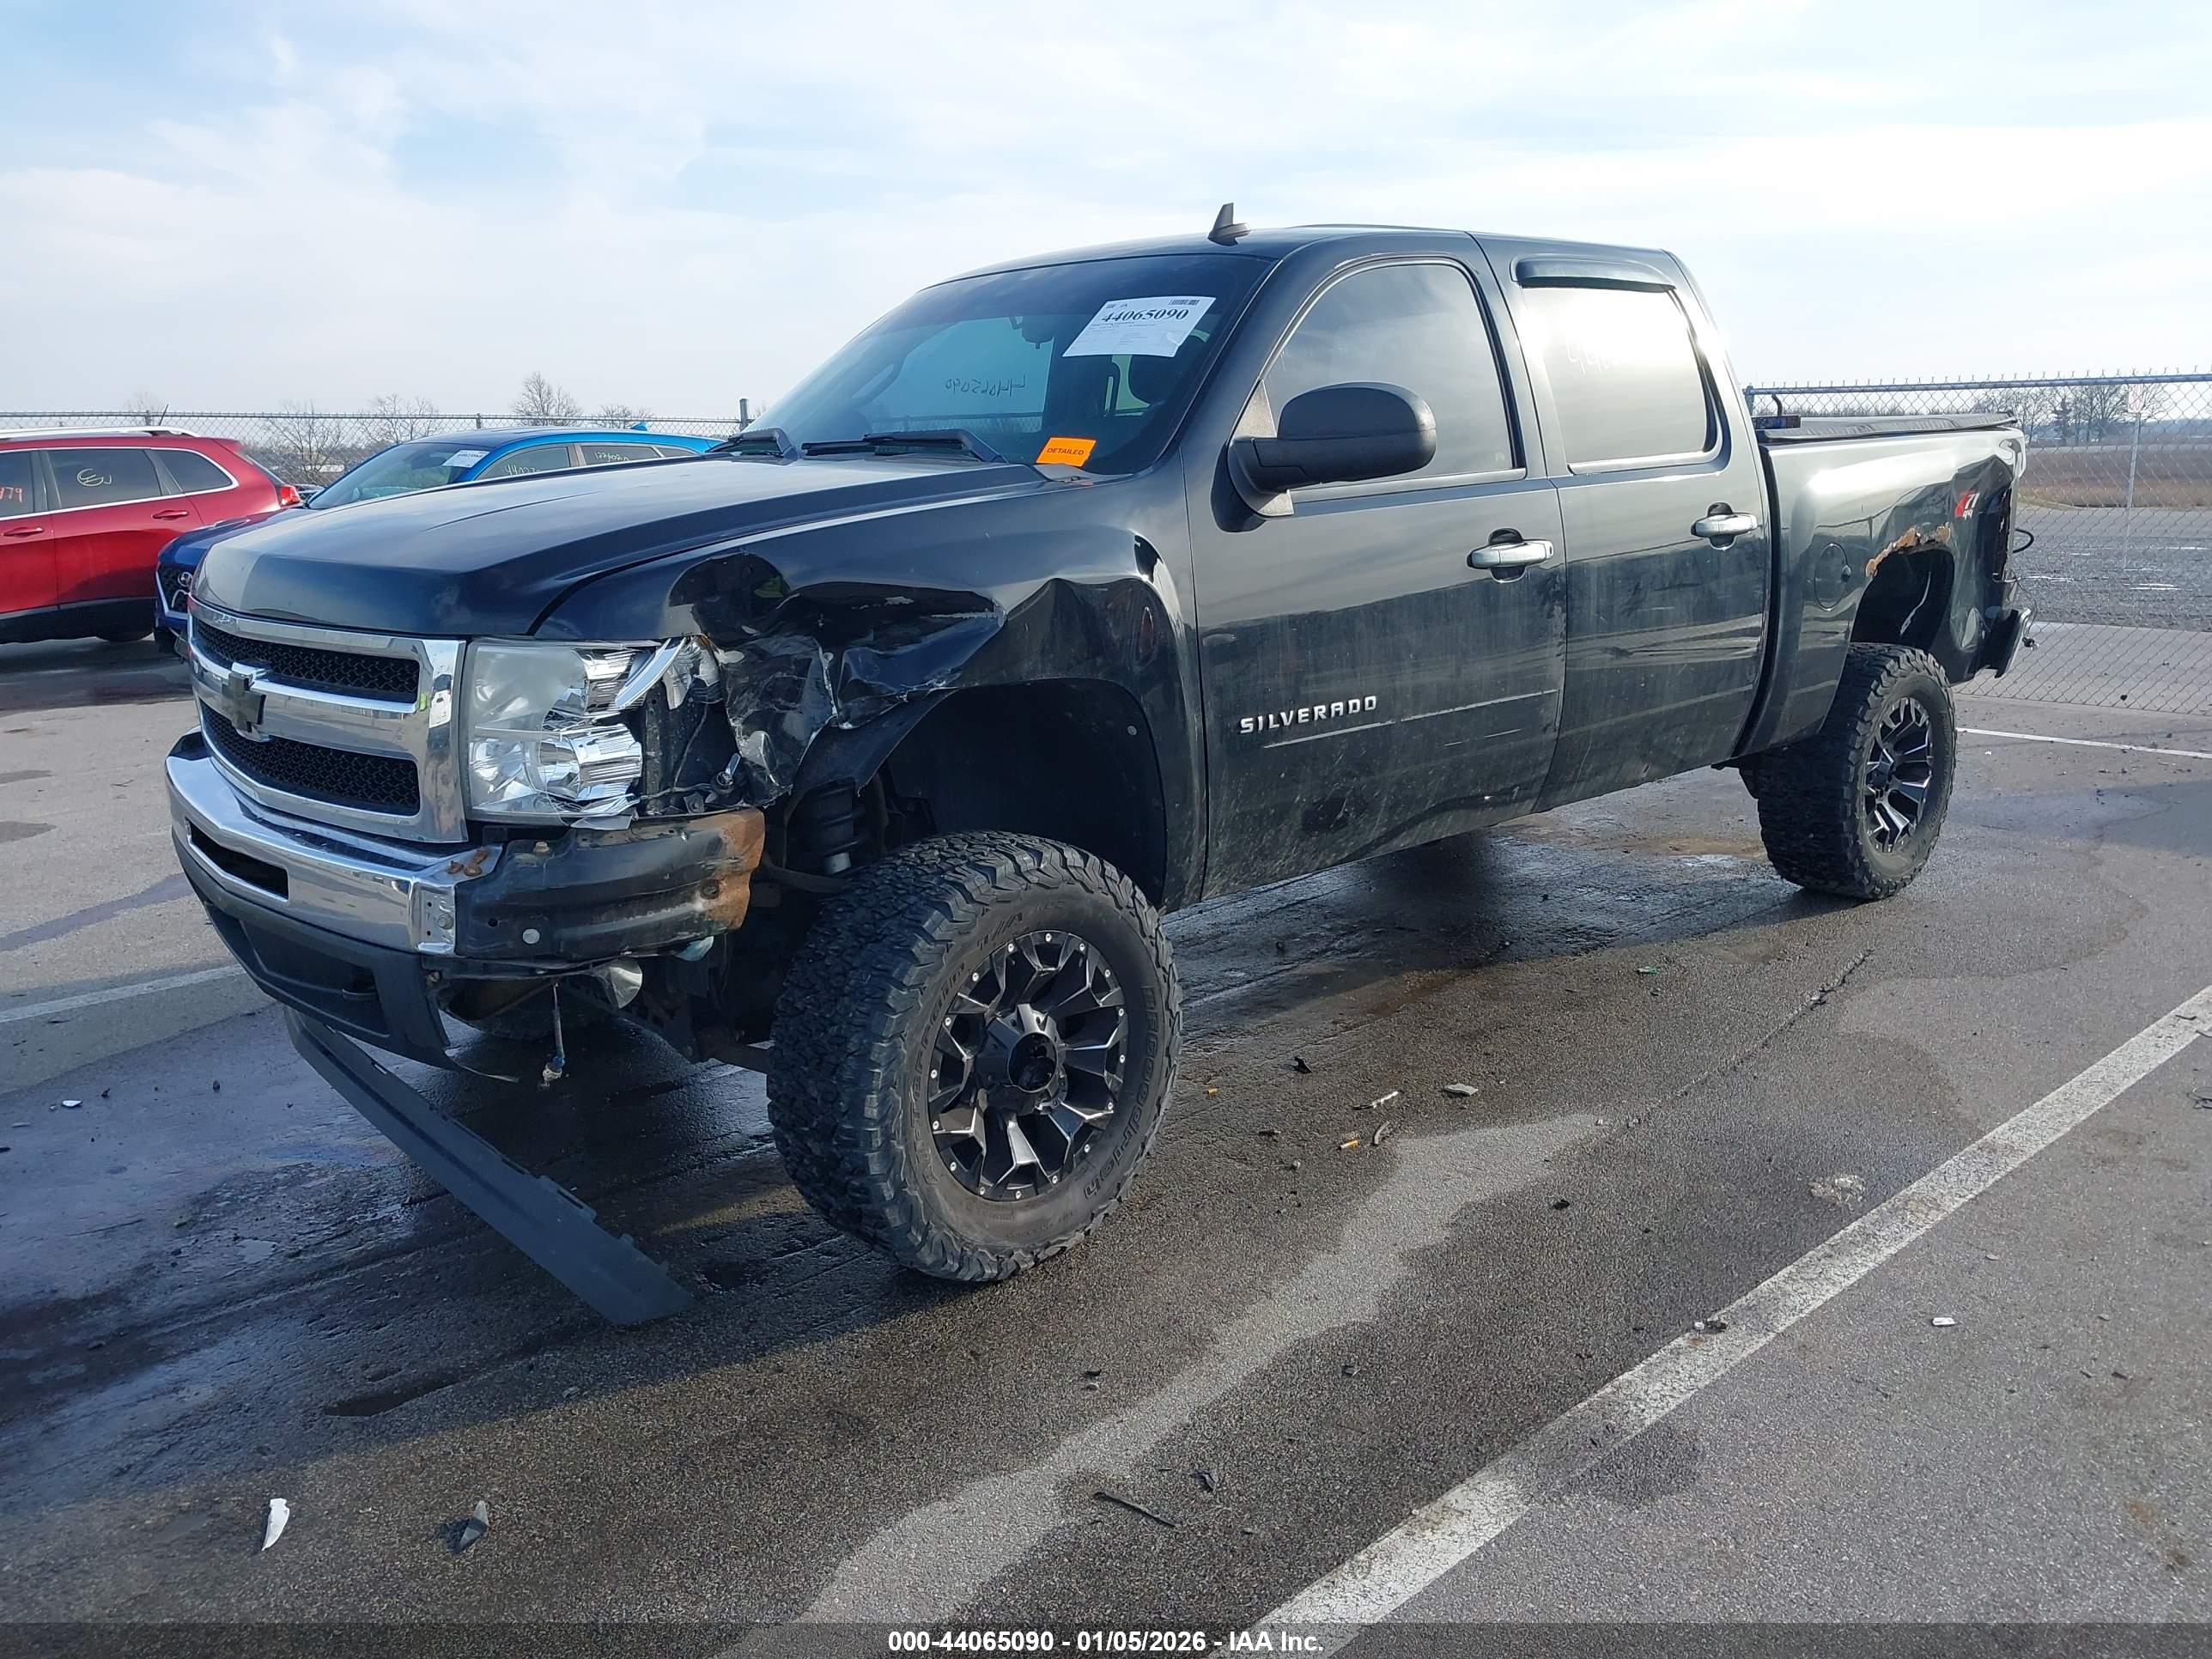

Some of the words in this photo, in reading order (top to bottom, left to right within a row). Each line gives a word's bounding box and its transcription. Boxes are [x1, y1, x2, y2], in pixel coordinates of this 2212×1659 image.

[1101, 307, 1189, 323] 44065090
[1046, 447, 1085, 456] DETAILED
[1239, 695, 1377, 735] SILVERADO
